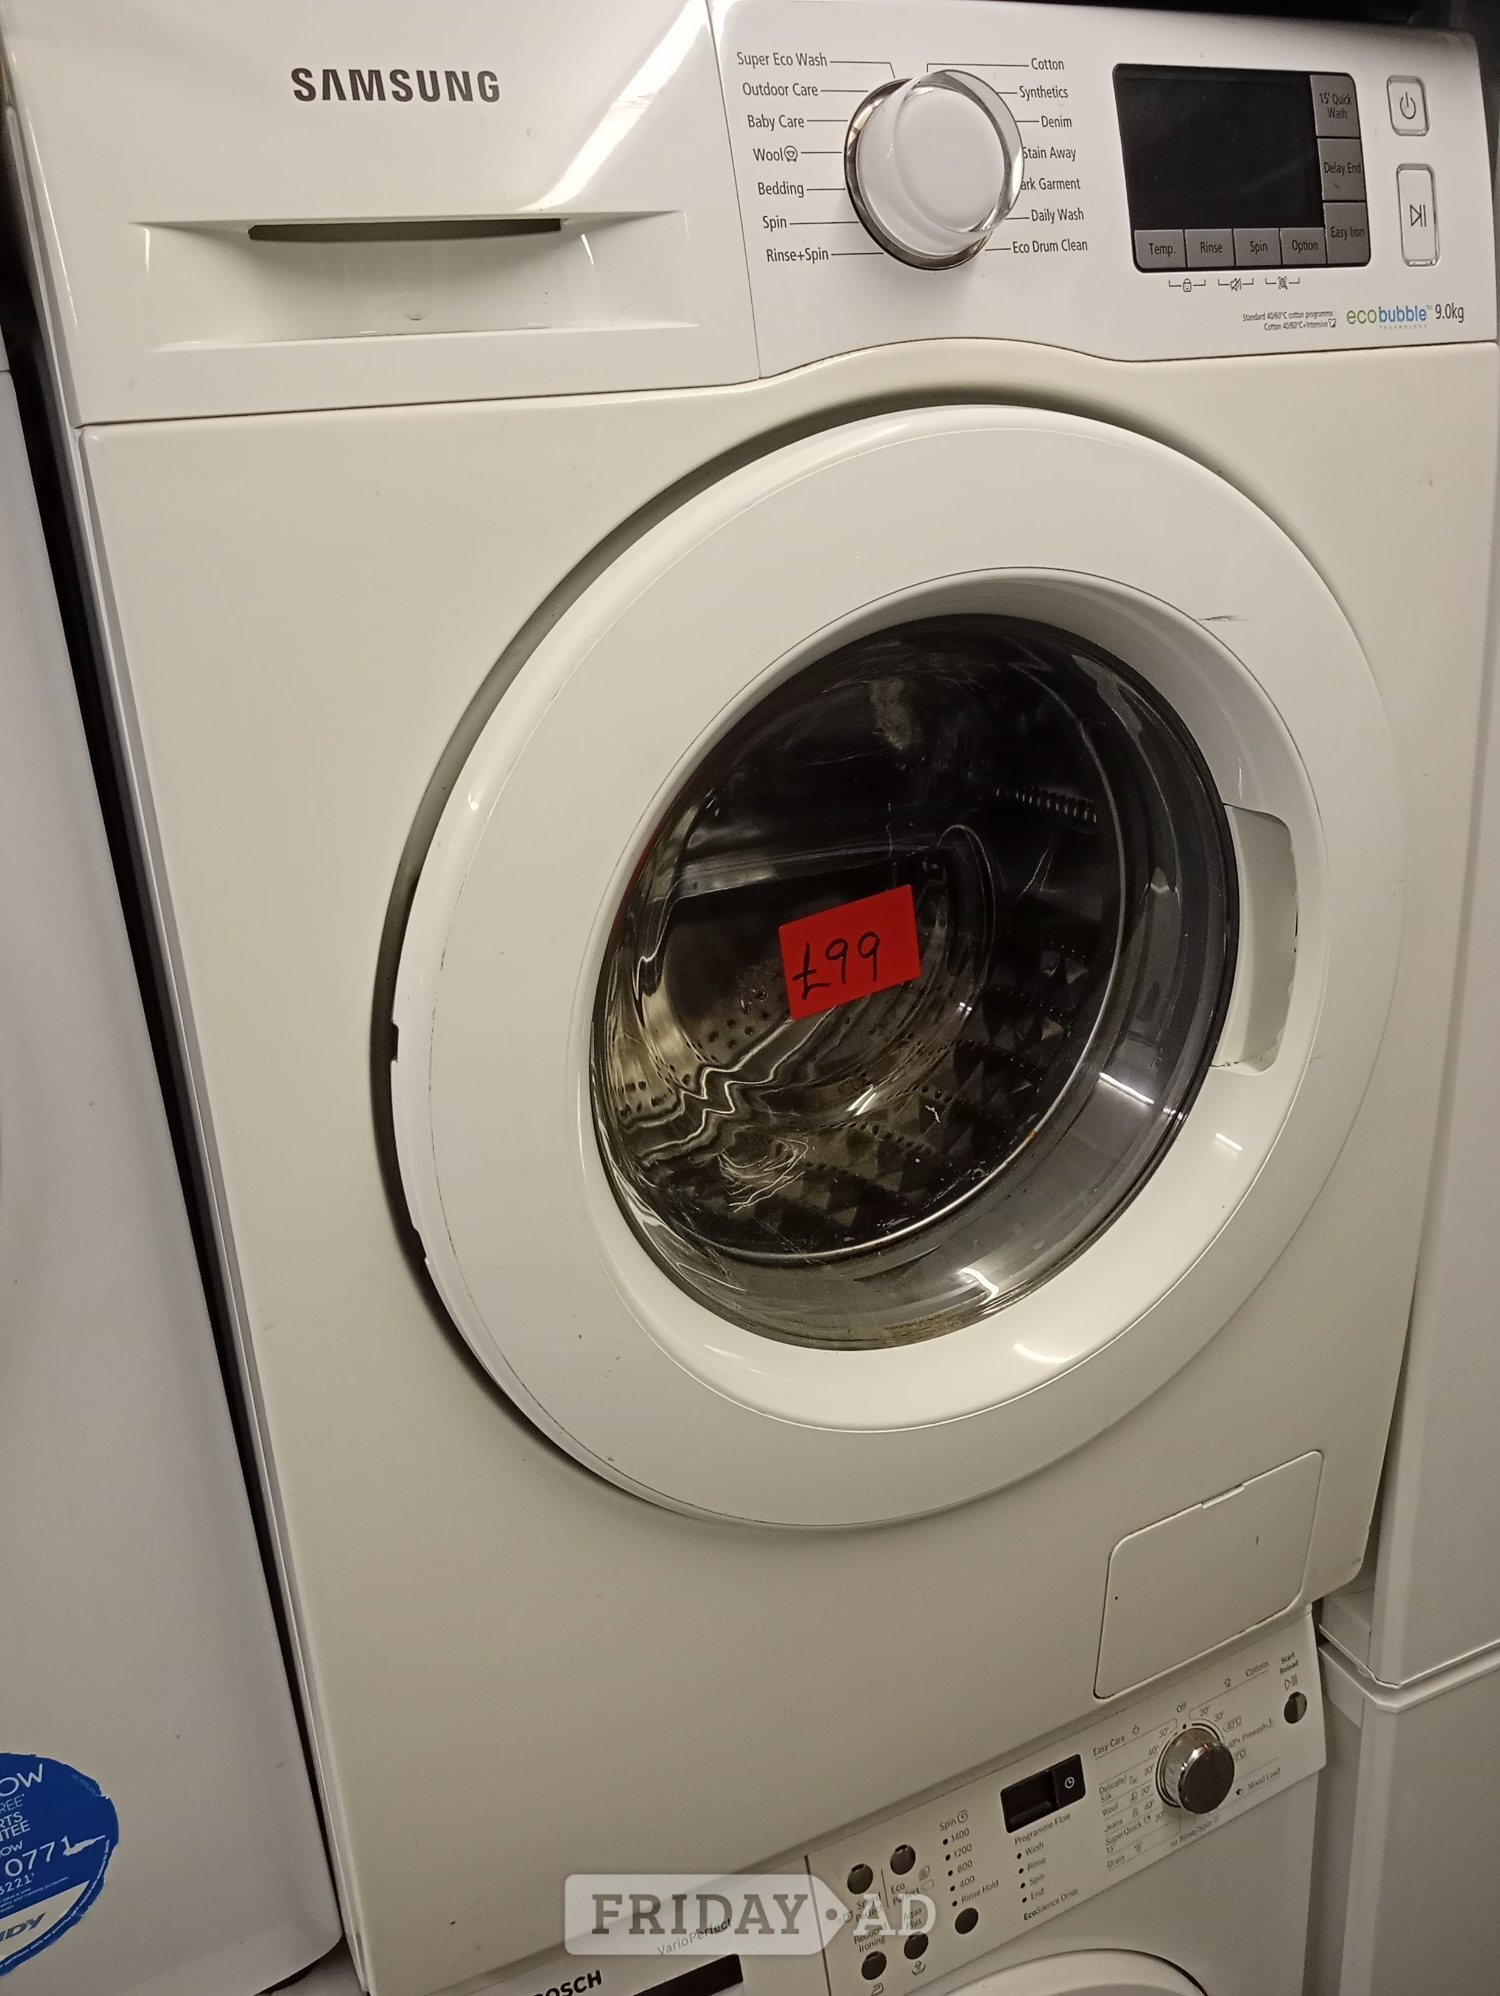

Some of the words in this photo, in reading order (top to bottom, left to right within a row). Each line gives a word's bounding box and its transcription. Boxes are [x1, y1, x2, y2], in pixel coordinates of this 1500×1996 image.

[736, 51, 770, 69] Super
[772, 52, 794, 66] Eco
[795, 52, 828, 67] Wash
[1031, 57, 1065, 70] Cotton
[290, 67, 501, 103] SAMSUNG
[742, 82, 789, 96] Outdoor
[792, 82, 819, 96] Care
[1019, 85, 1069, 102] Synthetics
[1331, 92, 1352, 105] Quick
[1326, 106, 1348, 119] Wash
[747, 114, 775, 132] Baby
[778, 114, 805, 128] Care
[1041, 115, 1073, 128] Denim
[752, 147, 784, 162] Wool
[1022, 146, 1048, 160] Stain
[1049, 146, 1077, 162] Away
[1323, 161, 1345, 176] Delay
[1347, 161, 1362, 174] End
[757, 181, 805, 199] Bedding
[1020, 177, 1037, 191] ark
[1038, 177, 1082, 191] Garment
[762, 214, 788, 232] Spin
[1031, 208, 1056, 225] Daily
[1057, 207, 1085, 221] Wash
[1330, 226, 1348, 240] Easy
[1349, 226, 1365, 238] Iron
[1012, 241, 1031, 254] Eco
[1032, 240, 1059, 253] Drum
[1061, 238, 1089, 252] Clean
[1149, 242, 1177, 257] Temp.
[1199, 241, 1223, 254] Rinse
[1249, 239, 1269, 253] Spin
[1291, 238, 1319, 253] Option
[766, 247, 829, 265] Rinse+Spin
[1435, 302, 1465, 323] 9.0kg
[791, 930, 881, 1001] £99
[939, 1817, 957, 1832] Spin
[951, 1827, 970, 1843] 1400
[1014, 1821, 1054, 1846] Programme
[954, 1843, 973, 1859] 1200
[1025, 1841, 1045, 1857] Wash
[957, 1859, 973, 1874] 800
[960, 1875, 976, 1889] 400
[982, 1879, 1000, 1894] Hold
[656, 1918, 732, 1956] VarioPerfect
